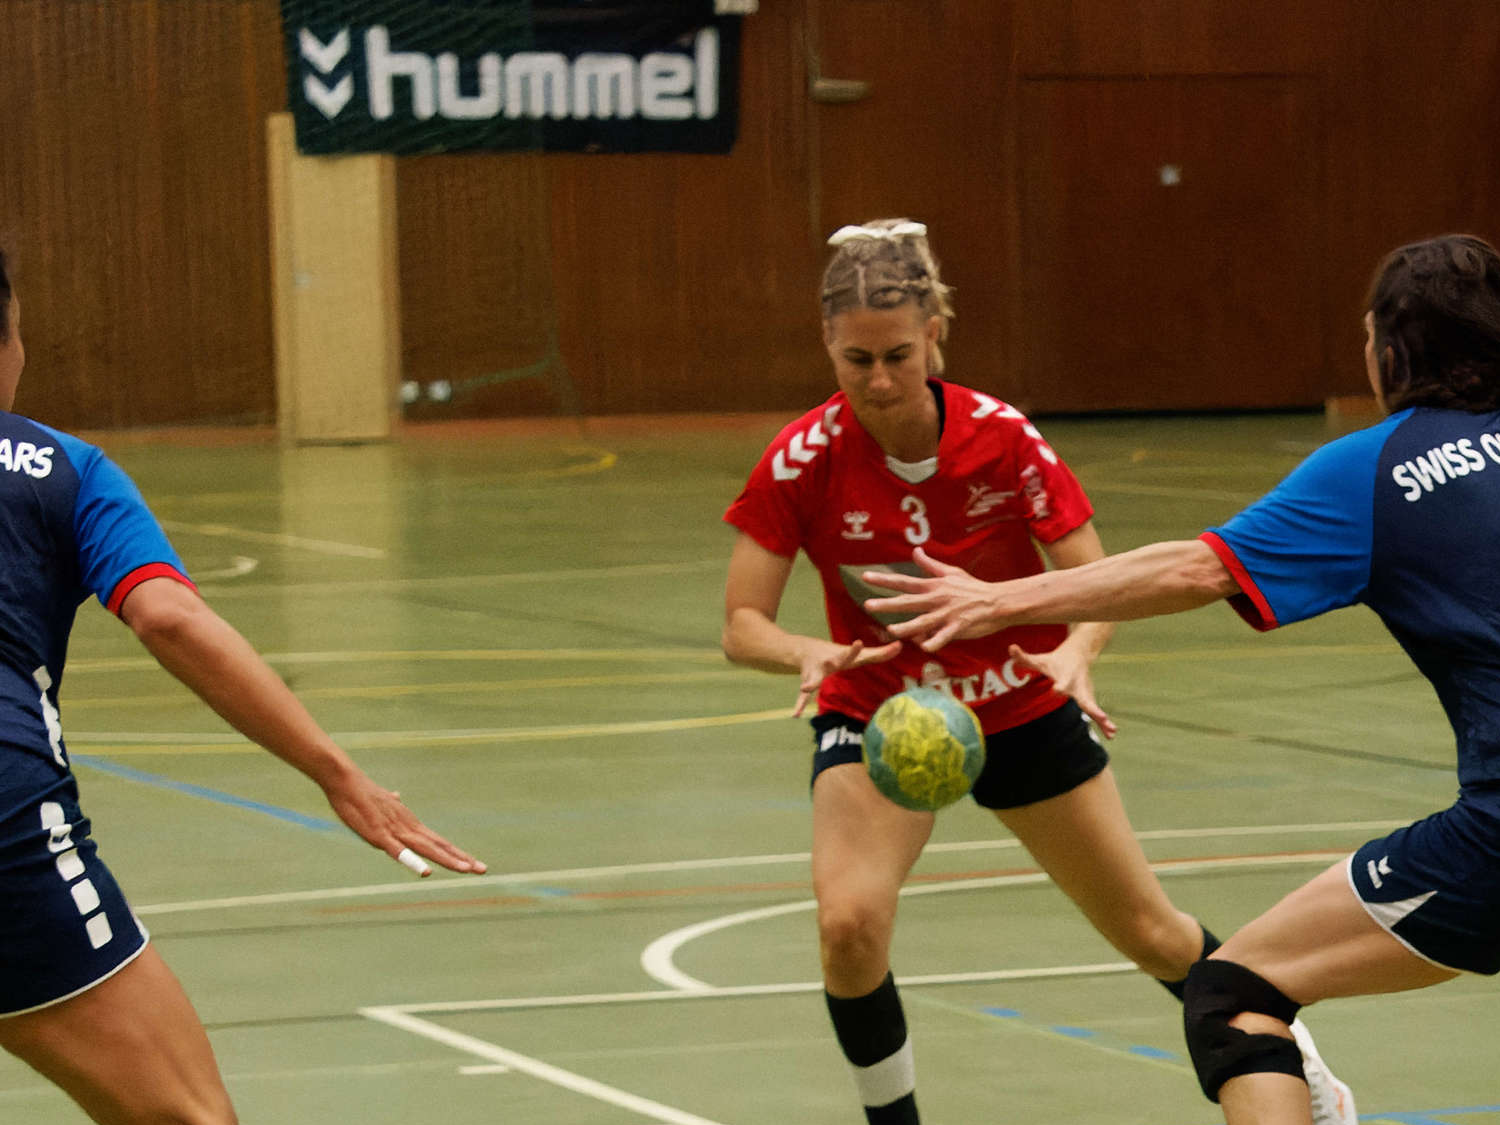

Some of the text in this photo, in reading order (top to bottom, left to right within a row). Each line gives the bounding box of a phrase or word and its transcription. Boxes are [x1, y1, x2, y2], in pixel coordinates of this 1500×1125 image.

[365, 25, 719, 119] hummel
[1392, 438, 1486, 502] SWISS
[901, 496, 931, 545] 3
